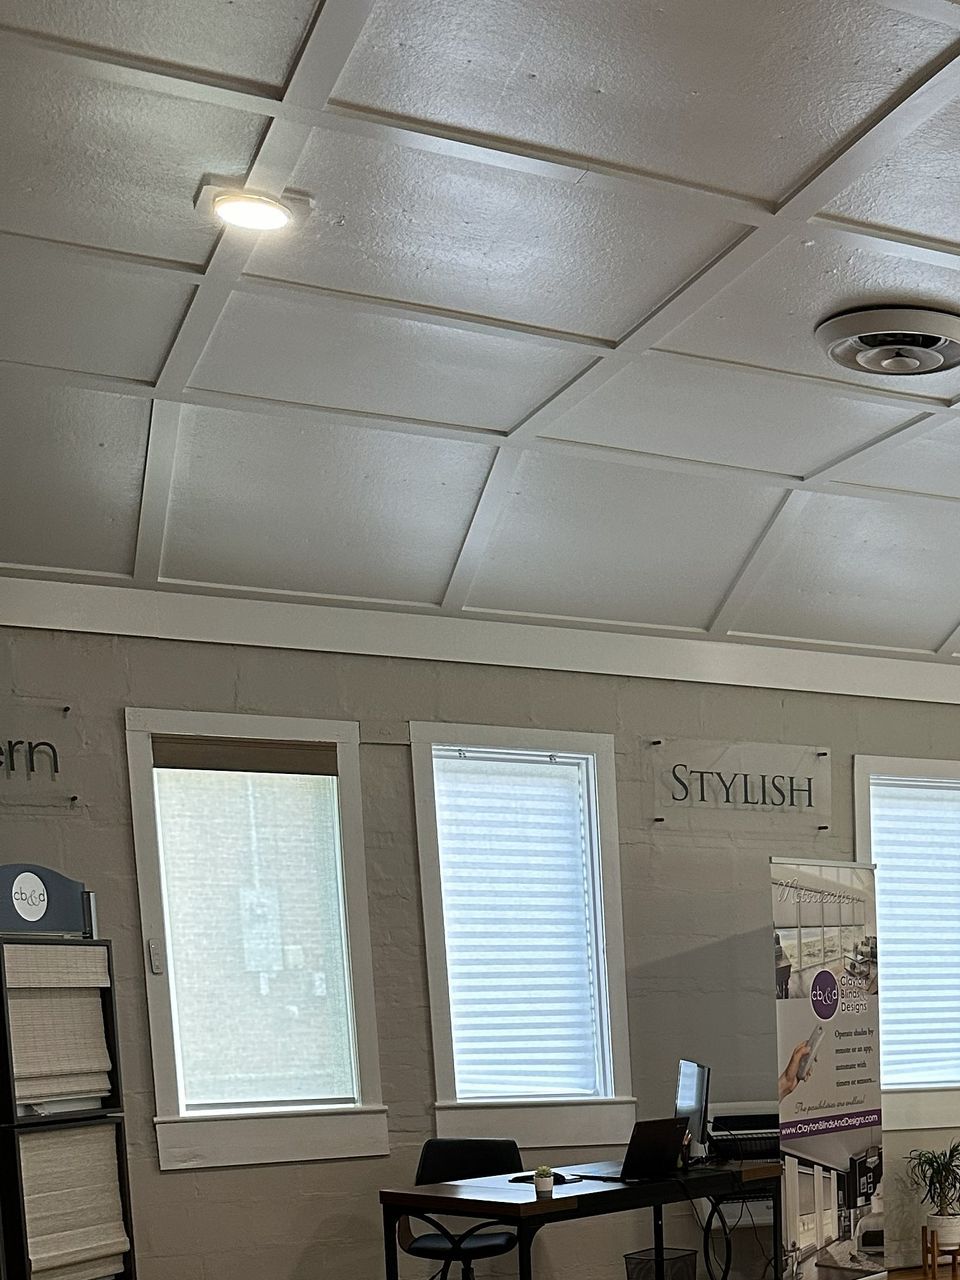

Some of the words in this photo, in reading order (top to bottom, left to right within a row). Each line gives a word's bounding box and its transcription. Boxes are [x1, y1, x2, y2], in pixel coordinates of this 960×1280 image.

[0, 740, 59, 774] rn
[671, 763, 815, 808] STYLISH
[811, 985, 838, 1005] cb&d
[841, 1002, 868, 1014] Designs
[781, 1114, 879, 1136] www.ClaytonBlindsAndDesigns.com
